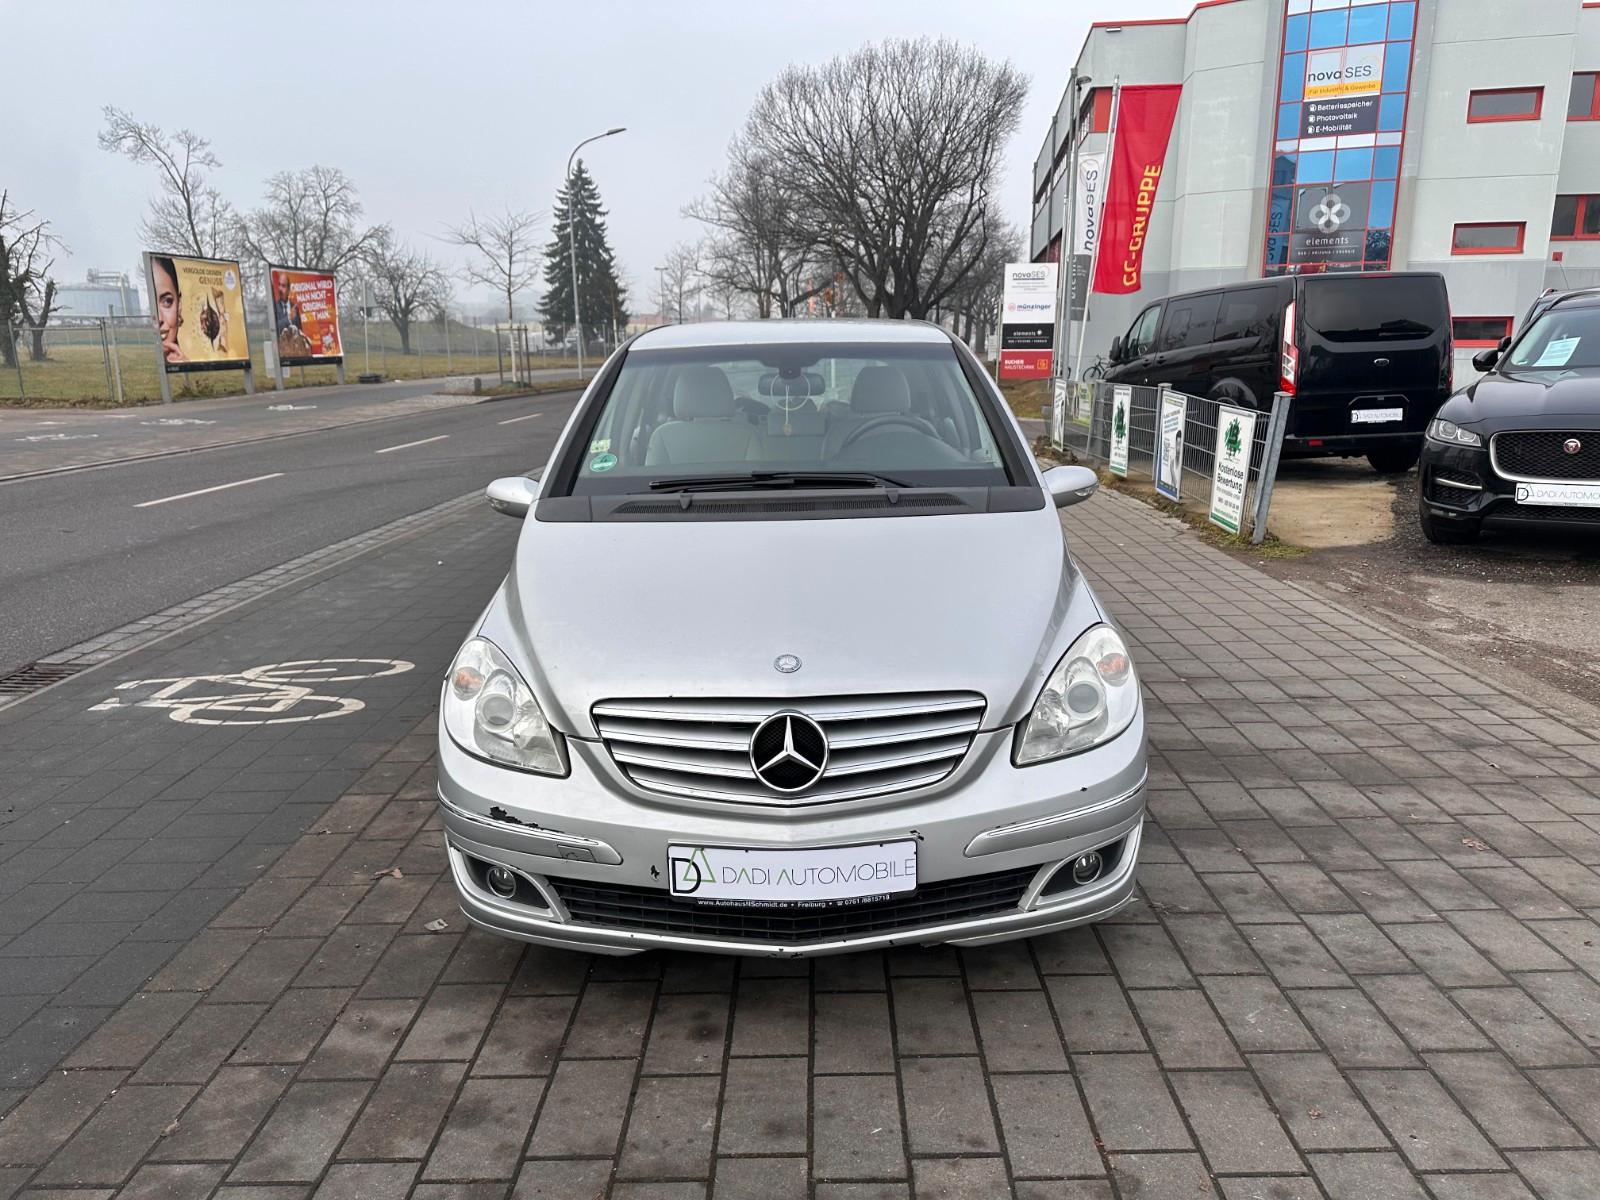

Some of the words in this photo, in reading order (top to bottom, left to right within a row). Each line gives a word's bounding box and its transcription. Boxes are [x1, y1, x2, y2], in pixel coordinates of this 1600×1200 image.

[1317, 100, 1373, 111] Batteriespeicher
[1316, 112, 1358, 122] Photovoltaik
[1315, 124, 1352, 133] E-Mobilität
[1084, 169, 1098, 251] novaSES
[1123, 165, 1161, 286] GC-GRUPPE
[1305, 236, 1349, 246] elements
[1218, 461, 1244, 480] Kostenlose
[1217, 473, 1243, 494] Bewertung
[722, 866, 771, 885] DADI
[776, 858, 916, 886] AUTOMOBILE
[797, 901, 826, 909] Freiburg
